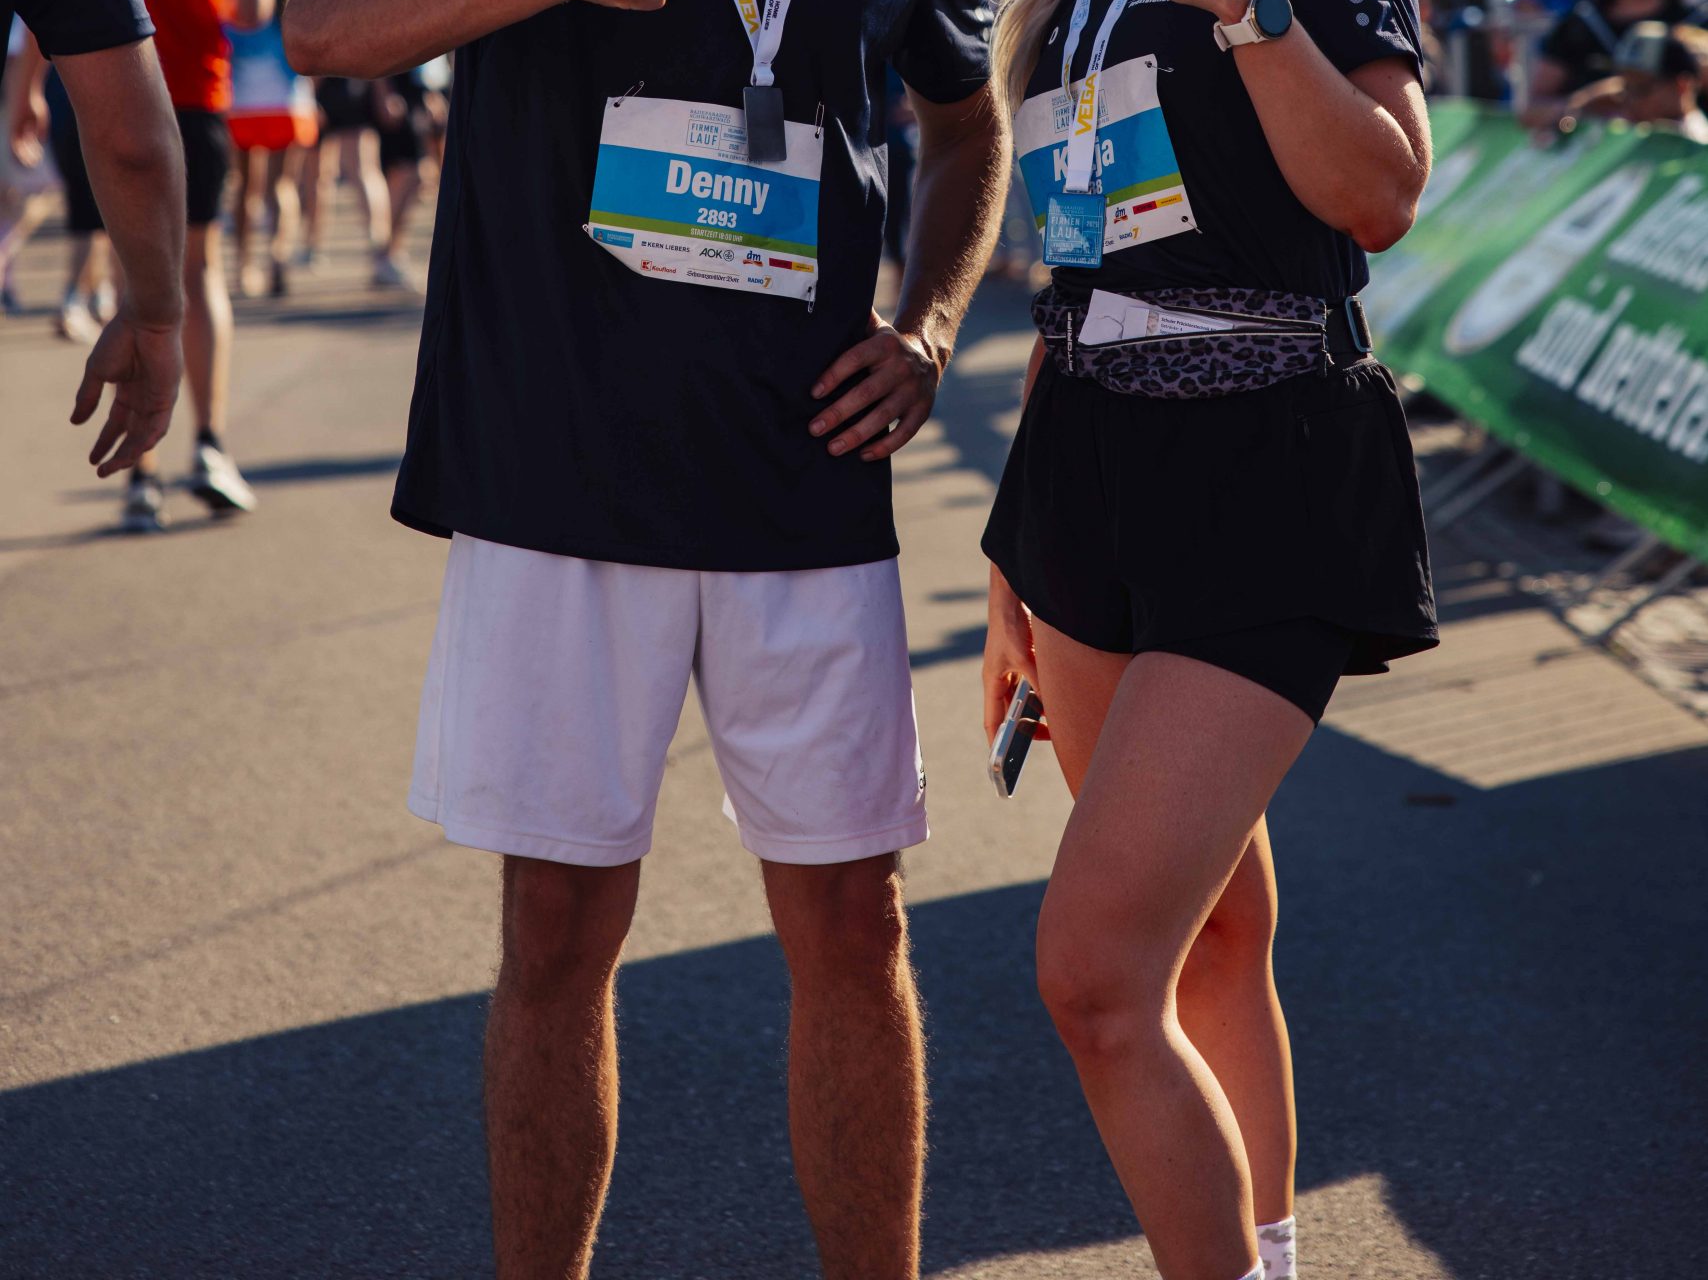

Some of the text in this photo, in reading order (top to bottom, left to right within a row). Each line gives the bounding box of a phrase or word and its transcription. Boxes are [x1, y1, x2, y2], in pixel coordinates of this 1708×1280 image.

[772, 0, 781, 19] HOME
[764, 8, 772, 31] VALUES
[1074, 72, 1098, 136] VEGA
[1055, 106, 1070, 117] FIRME
[692, 123, 719, 134] FIRMEN
[1056, 116, 1070, 130] LAU
[690, 132, 718, 146] LAUF
[1053, 137, 1115, 182] Kja
[665, 159, 770, 216] Denny
[696, 208, 737, 229] 2893
[1051, 216, 1080, 226] FIRMEN
[690, 228, 718, 238] STARTZEIT
[732, 234, 743, 242] UHR
[1050, 226, 1080, 239] LAUF
[1132, 227, 1139, 239] 7
[647, 241, 690, 252] KERN LIEBERS
[699, 247, 723, 259] AOK
[746, 250, 761, 261] dm
[651, 265, 677, 273] Kaufland
[763, 276, 772, 288] 7
